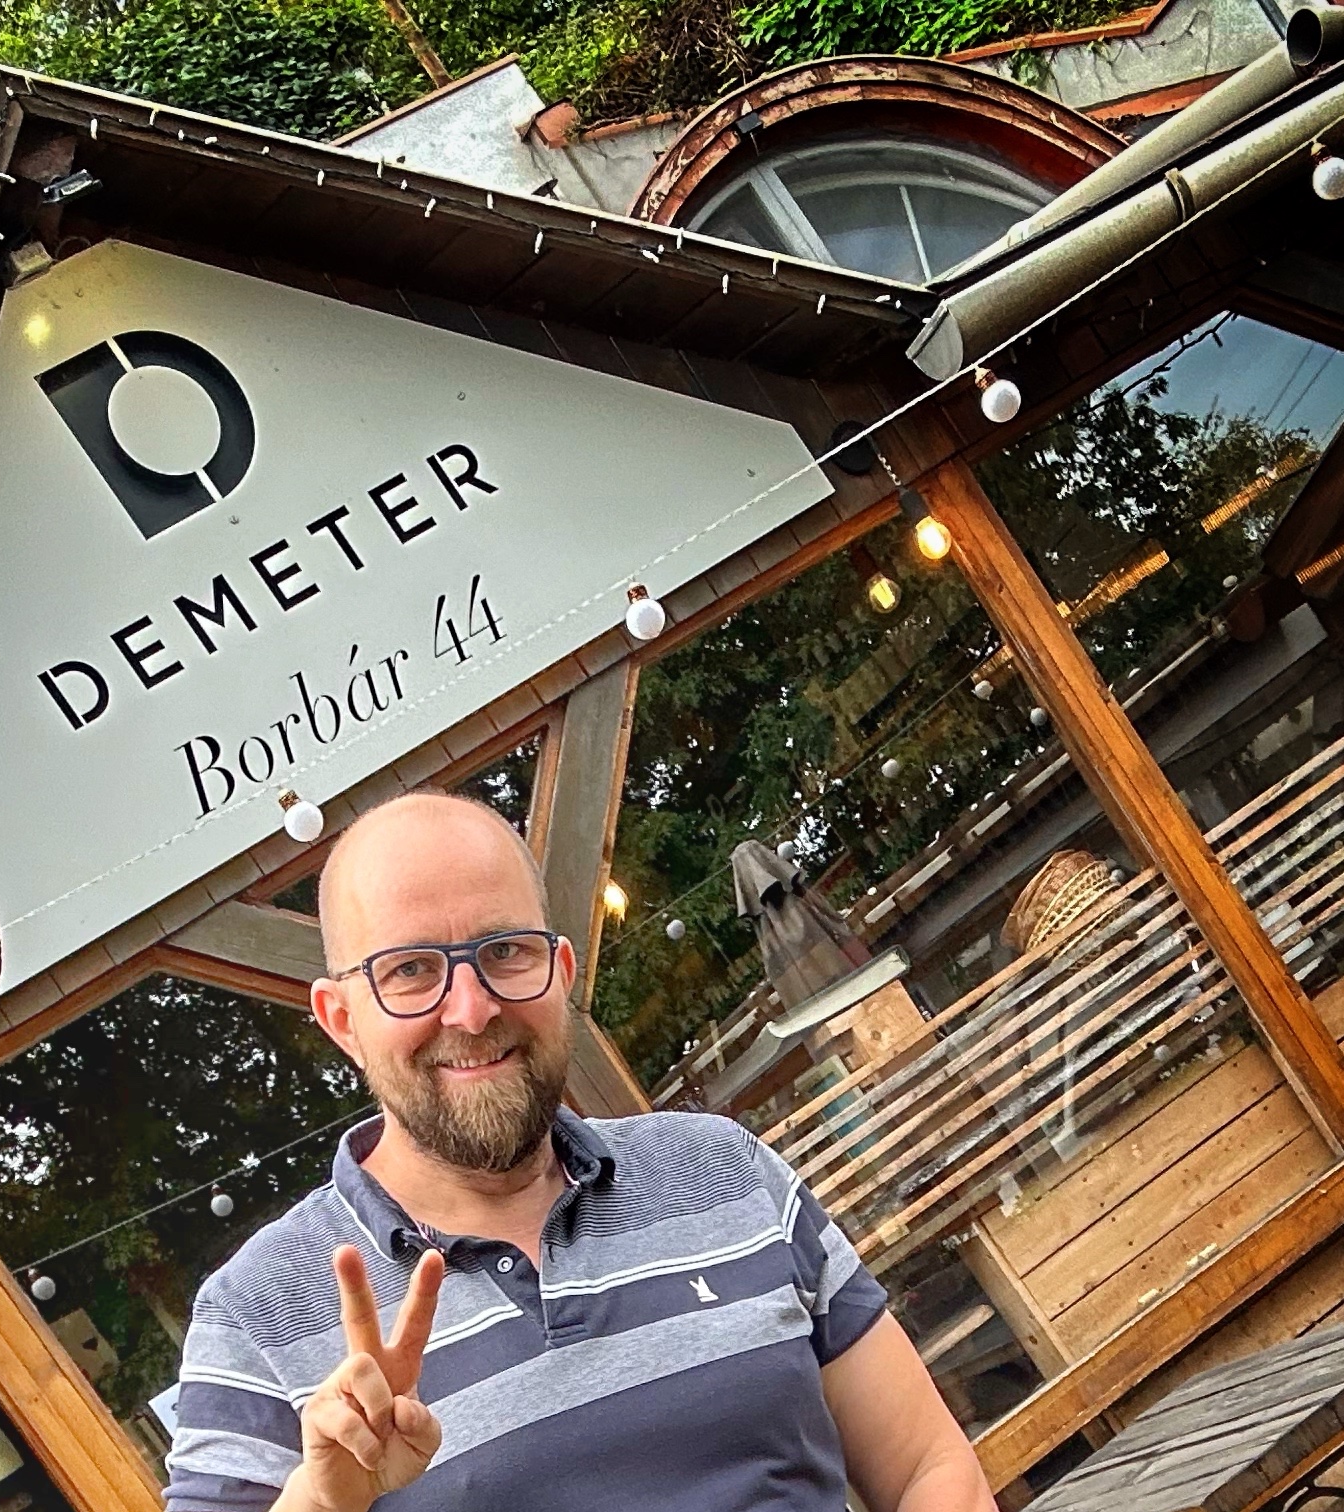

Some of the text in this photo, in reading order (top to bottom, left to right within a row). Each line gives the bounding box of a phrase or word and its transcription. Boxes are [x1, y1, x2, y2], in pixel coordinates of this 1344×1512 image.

[36, 442, 499, 731] DEMETER
[173, 573, 508, 820] Borbár 44
